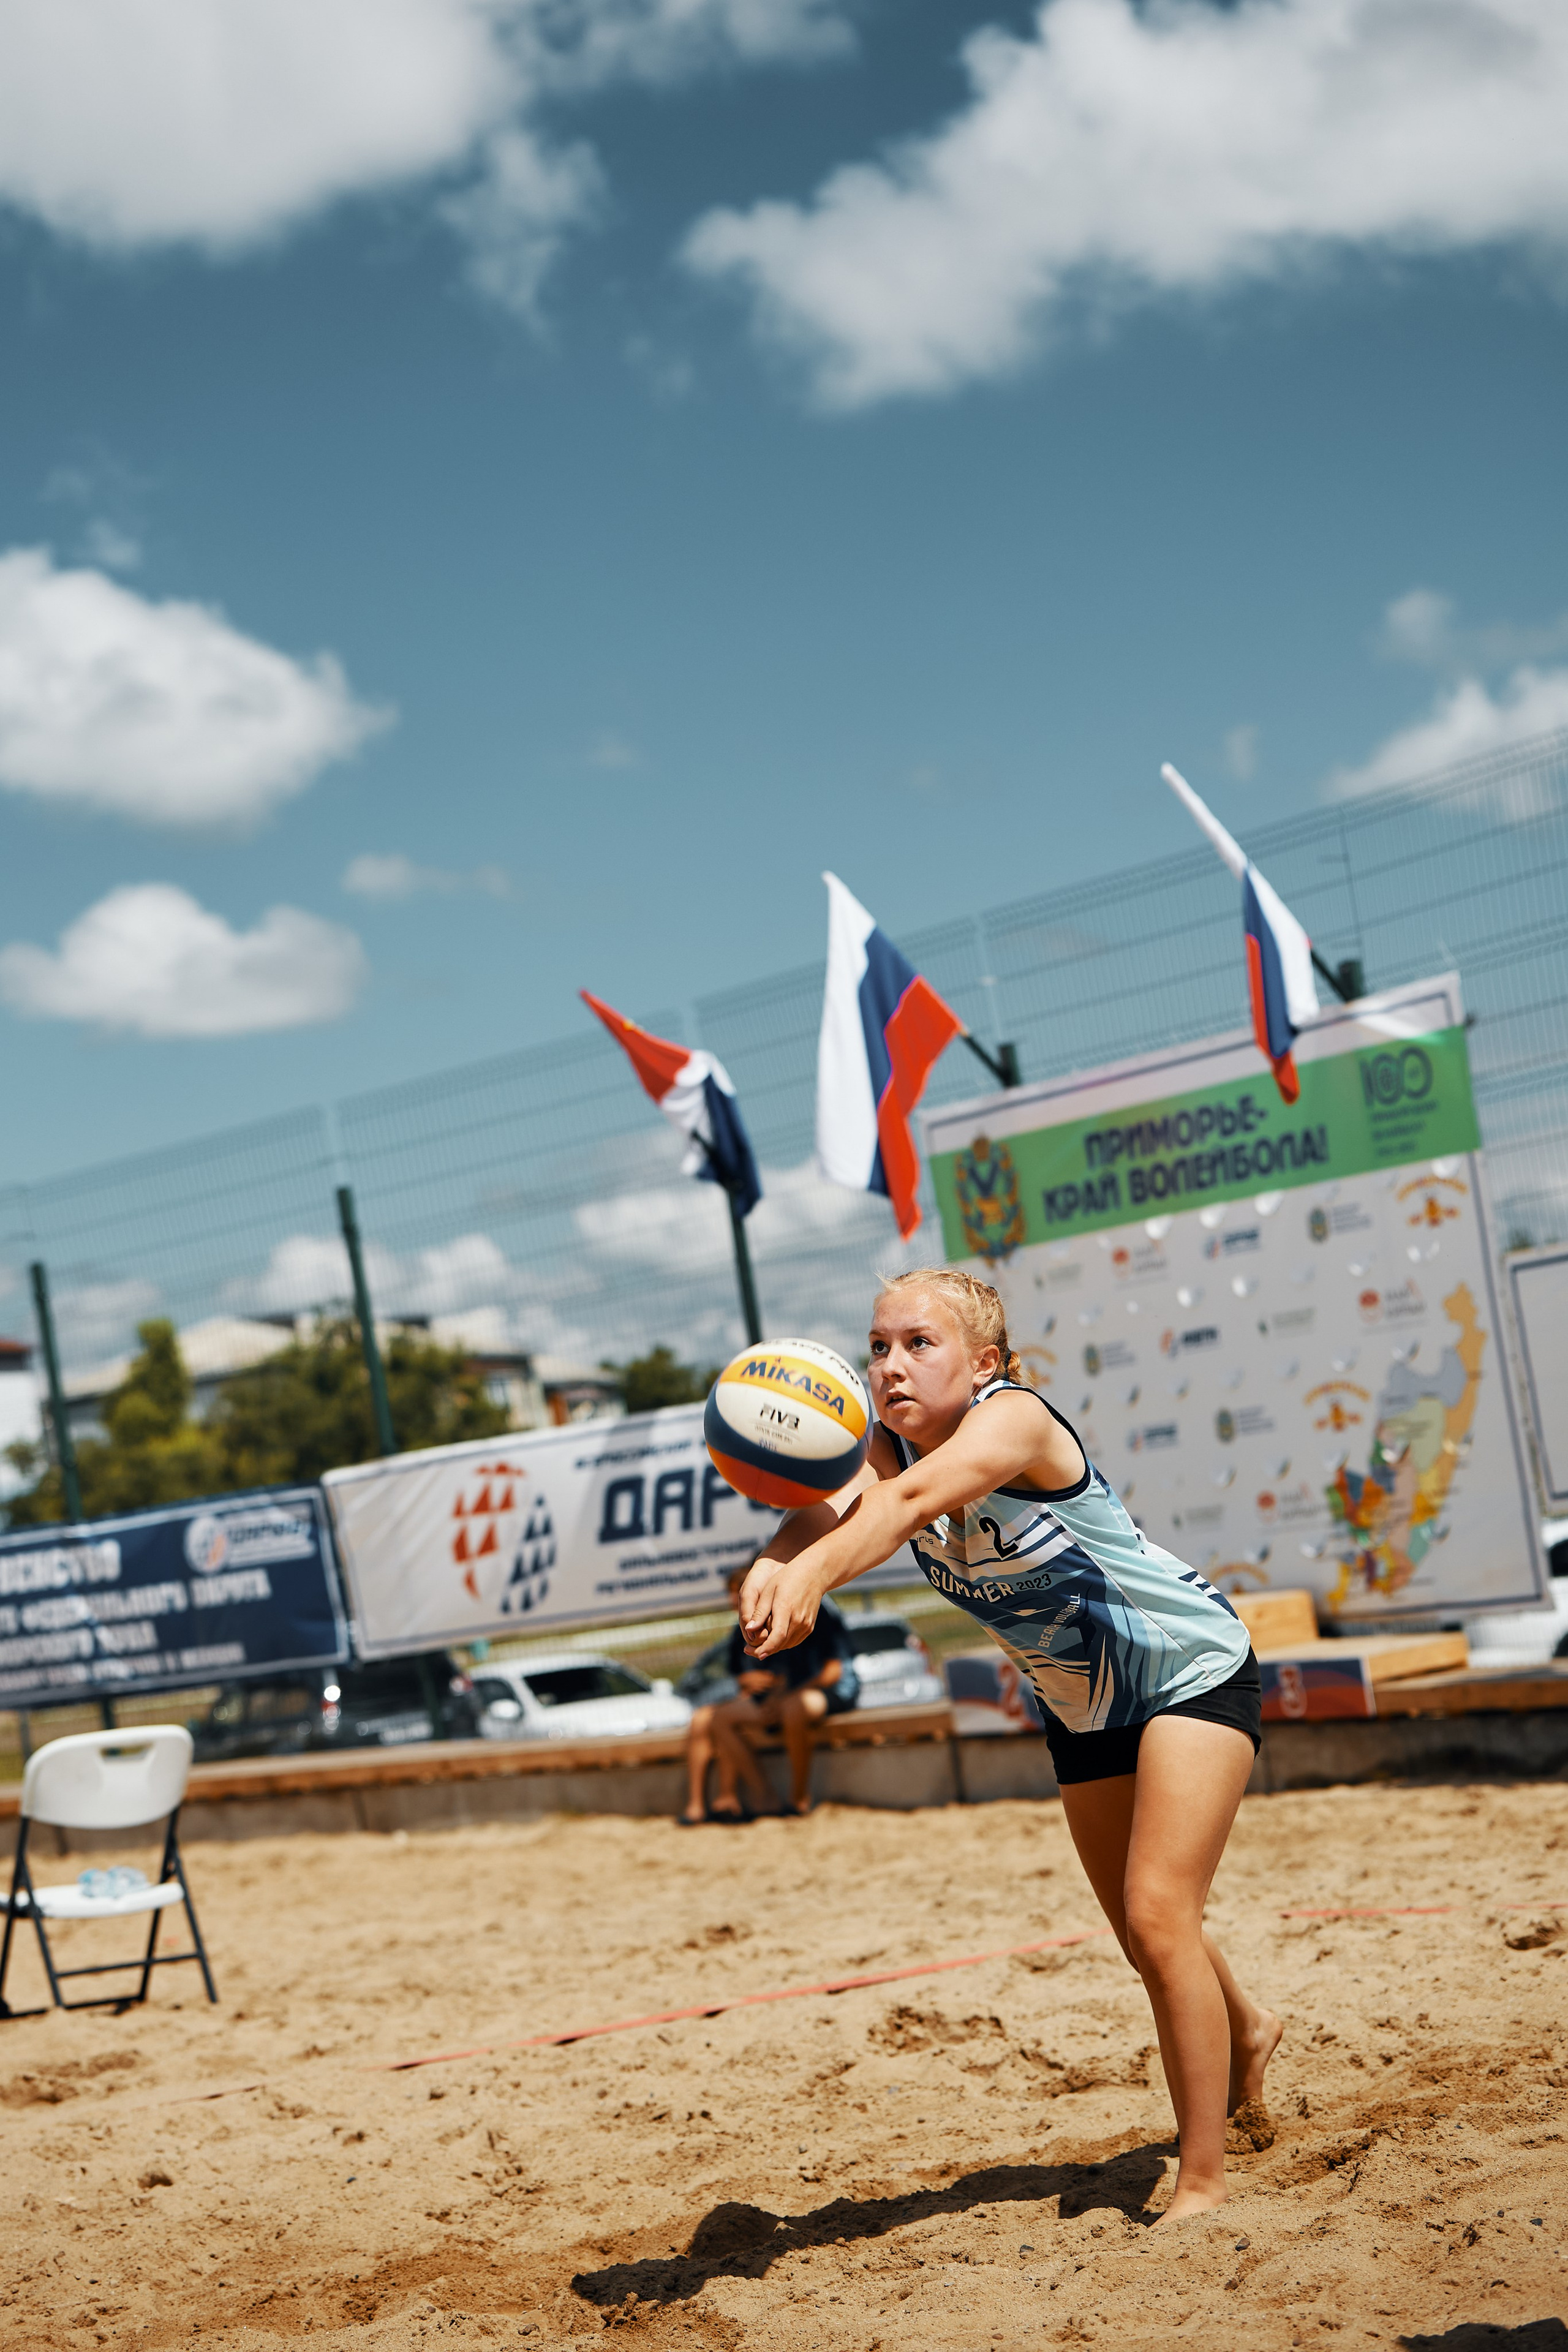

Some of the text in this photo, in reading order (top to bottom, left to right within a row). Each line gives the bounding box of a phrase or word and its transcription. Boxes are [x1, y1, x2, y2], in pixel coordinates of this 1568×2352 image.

[1084, 1095, 1267, 1168] ПРИМОРЬЕ-
[1043, 1125, 1330, 1224] КРАЙ ВОЛЕЙБОЛА!
[741, 1359, 845, 1417] MIKASA
[979, 1516, 1019, 1559] 2
[930, 1566, 1052, 1603] SUMMER 2023
[1038, 1623, 1062, 1648] BEACH
